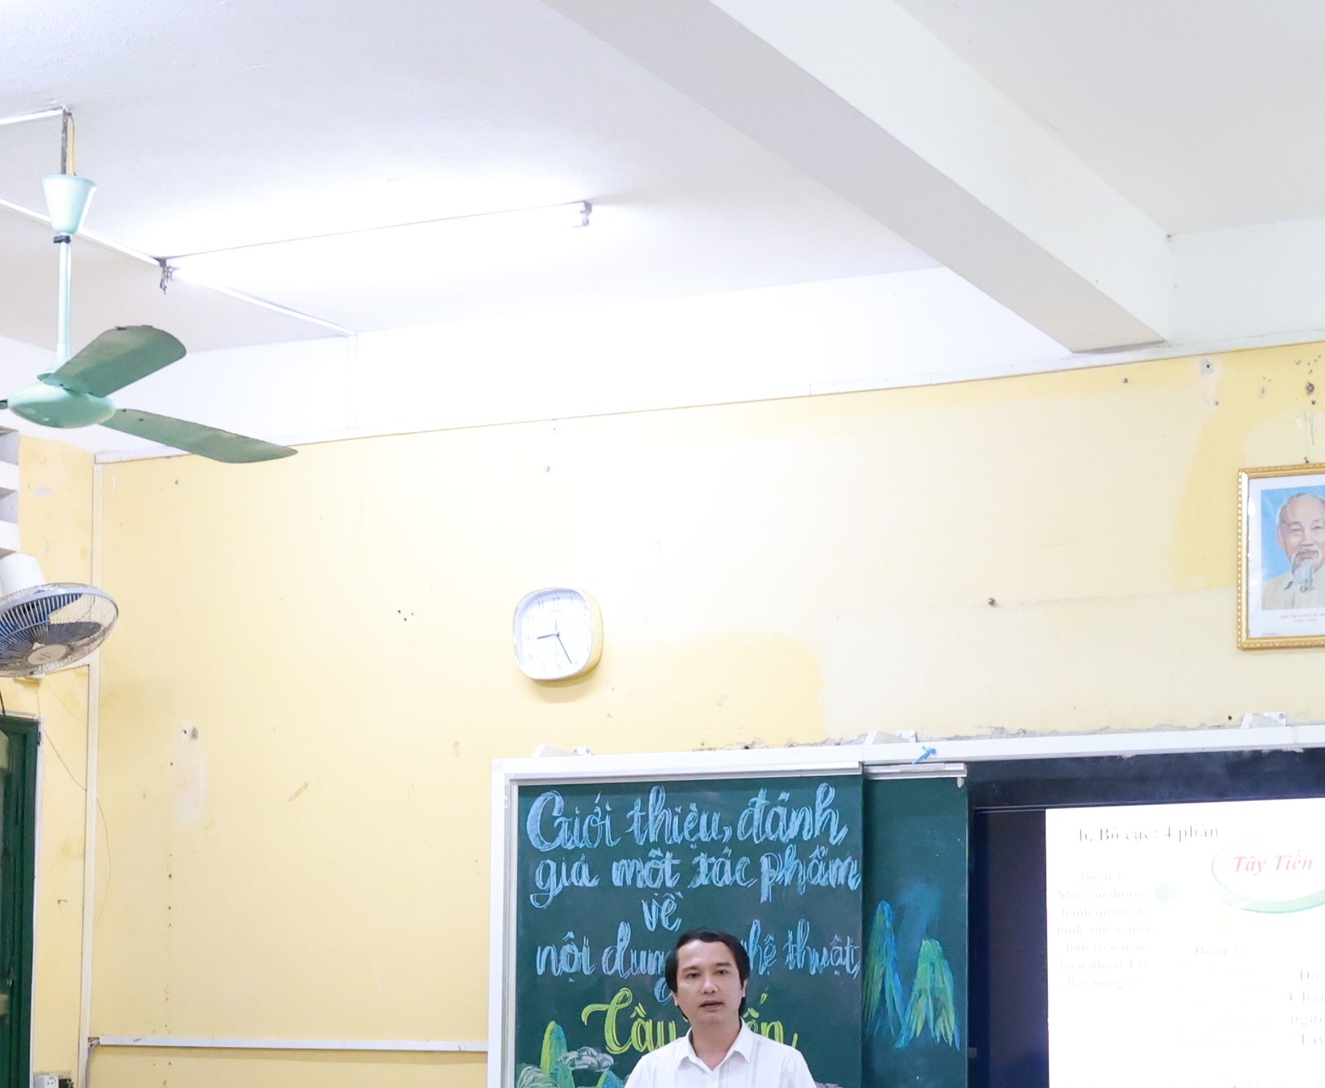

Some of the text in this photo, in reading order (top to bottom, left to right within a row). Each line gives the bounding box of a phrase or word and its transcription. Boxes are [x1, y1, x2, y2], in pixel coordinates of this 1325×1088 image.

[529, 853, 600, 909] giá
[612, 847, 681, 888] một
[760, 843, 862, 903] phẩm
[1233, 849, 1313, 876] Tây Tiến
[642, 890, 682, 932] về
[536, 931, 595, 983] nội
